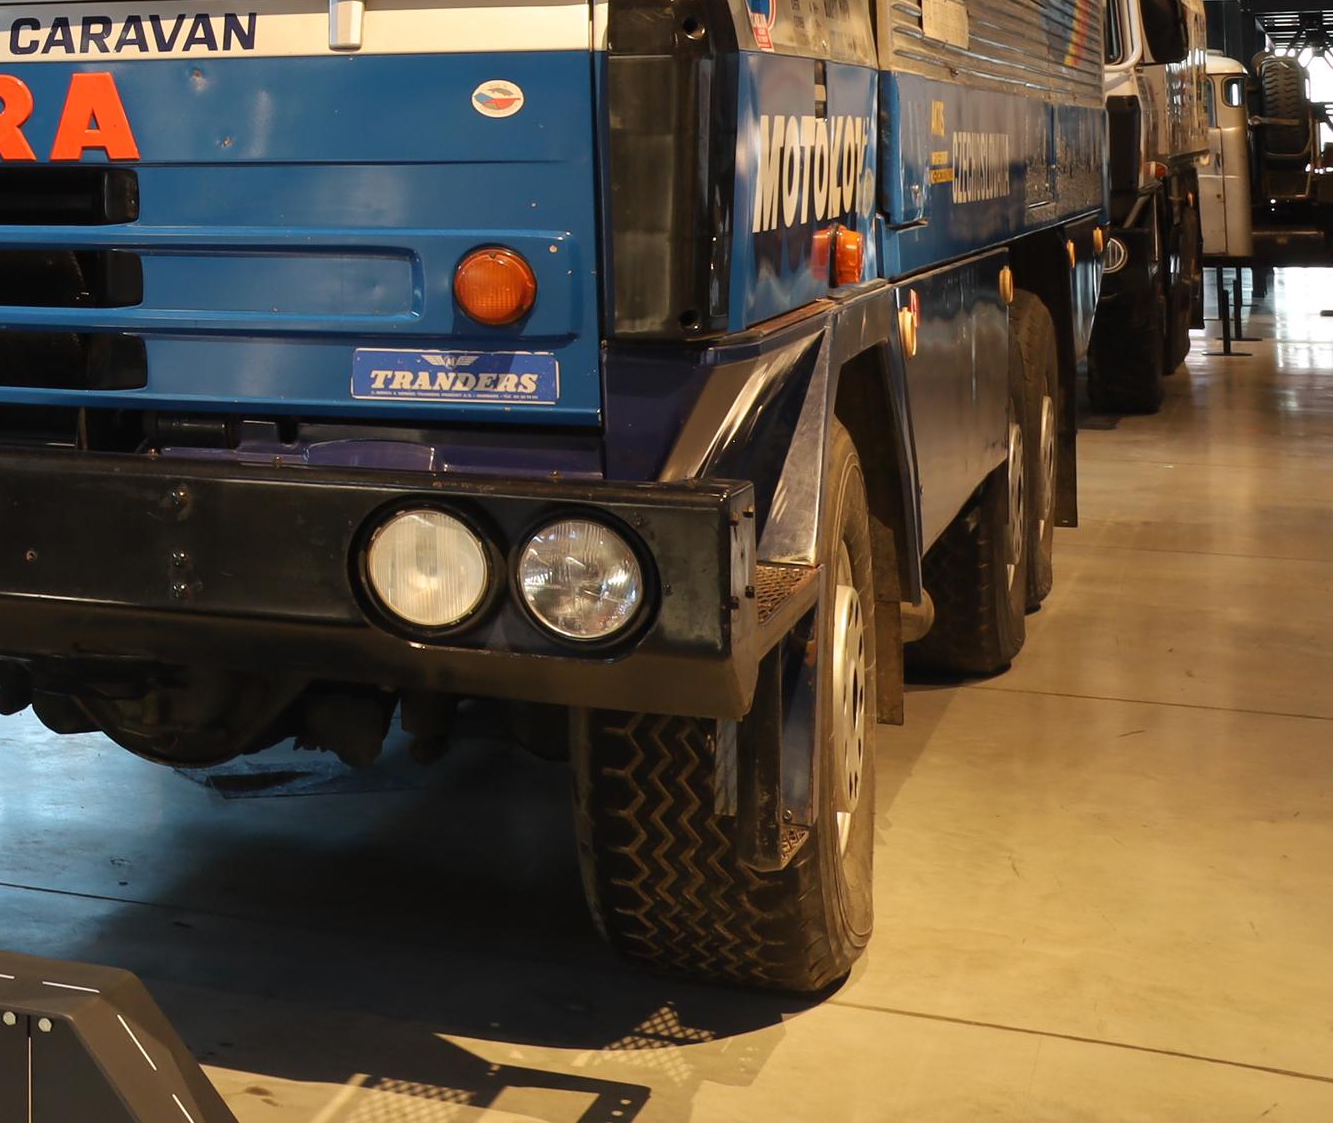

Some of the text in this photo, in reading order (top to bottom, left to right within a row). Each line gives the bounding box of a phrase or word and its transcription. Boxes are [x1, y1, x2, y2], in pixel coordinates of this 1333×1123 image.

[8, 12, 258, 56] CARAVAN
[752, 115, 870, 234] MOTOKOV
[370, 370, 539, 393] TRANDERS
